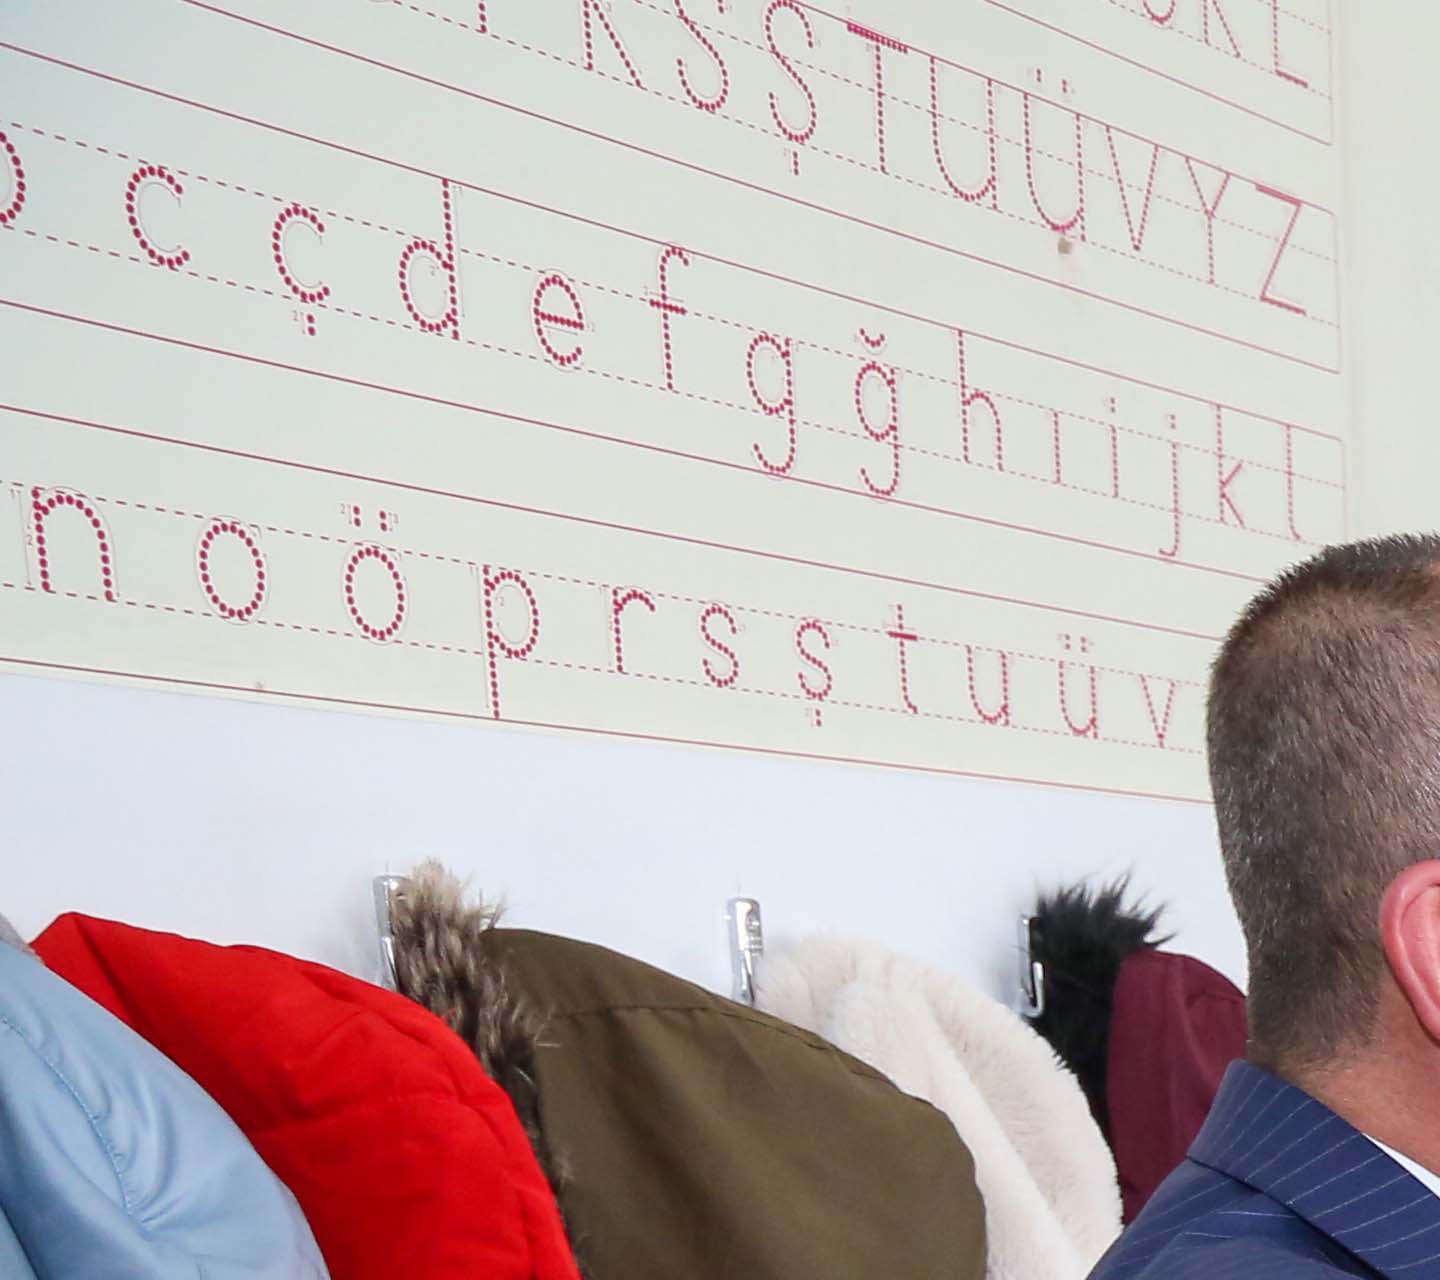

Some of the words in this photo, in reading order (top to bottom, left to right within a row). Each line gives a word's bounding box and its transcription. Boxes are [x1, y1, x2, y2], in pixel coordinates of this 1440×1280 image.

[765, 0, 817, 176] Ş
[848, 21, 908, 174] T
[930, 57, 998, 210] U
[1024, 68, 1086, 241] Ü
[1106, 126, 1160, 250] V
[1185, 156, 1230, 283] Y
[1255, 183, 1306, 316] Z
[126, 165, 190, 268] c
[272, 205, 330, 336] ç
[399, 178, 460, 340] d
[533, 274, 585, 365] e
[650, 245, 691, 391] f
[747, 333, 796, 474] g
[855, 328, 901, 497] ğ
[957, 330, 1004, 471] h
[1109, 397, 1120, 499] i
[1159, 414, 1180, 557] j
[1216, 404, 1245, 527] k
[1285, 425, 1301, 541] l
[31, 486, 114, 602] n
[200, 521, 265, 619] o
[345, 505, 404, 640] ö
[483, 564, 539, 720] p
[612, 587, 656, 673] r
[701, 603, 740, 688] s
[796, 620, 832, 726] ş
[887, 603, 918, 714] t
[966, 645, 1010, 727] u
[1058, 634, 1100, 739] ü
[1140, 674, 1175, 749] v
